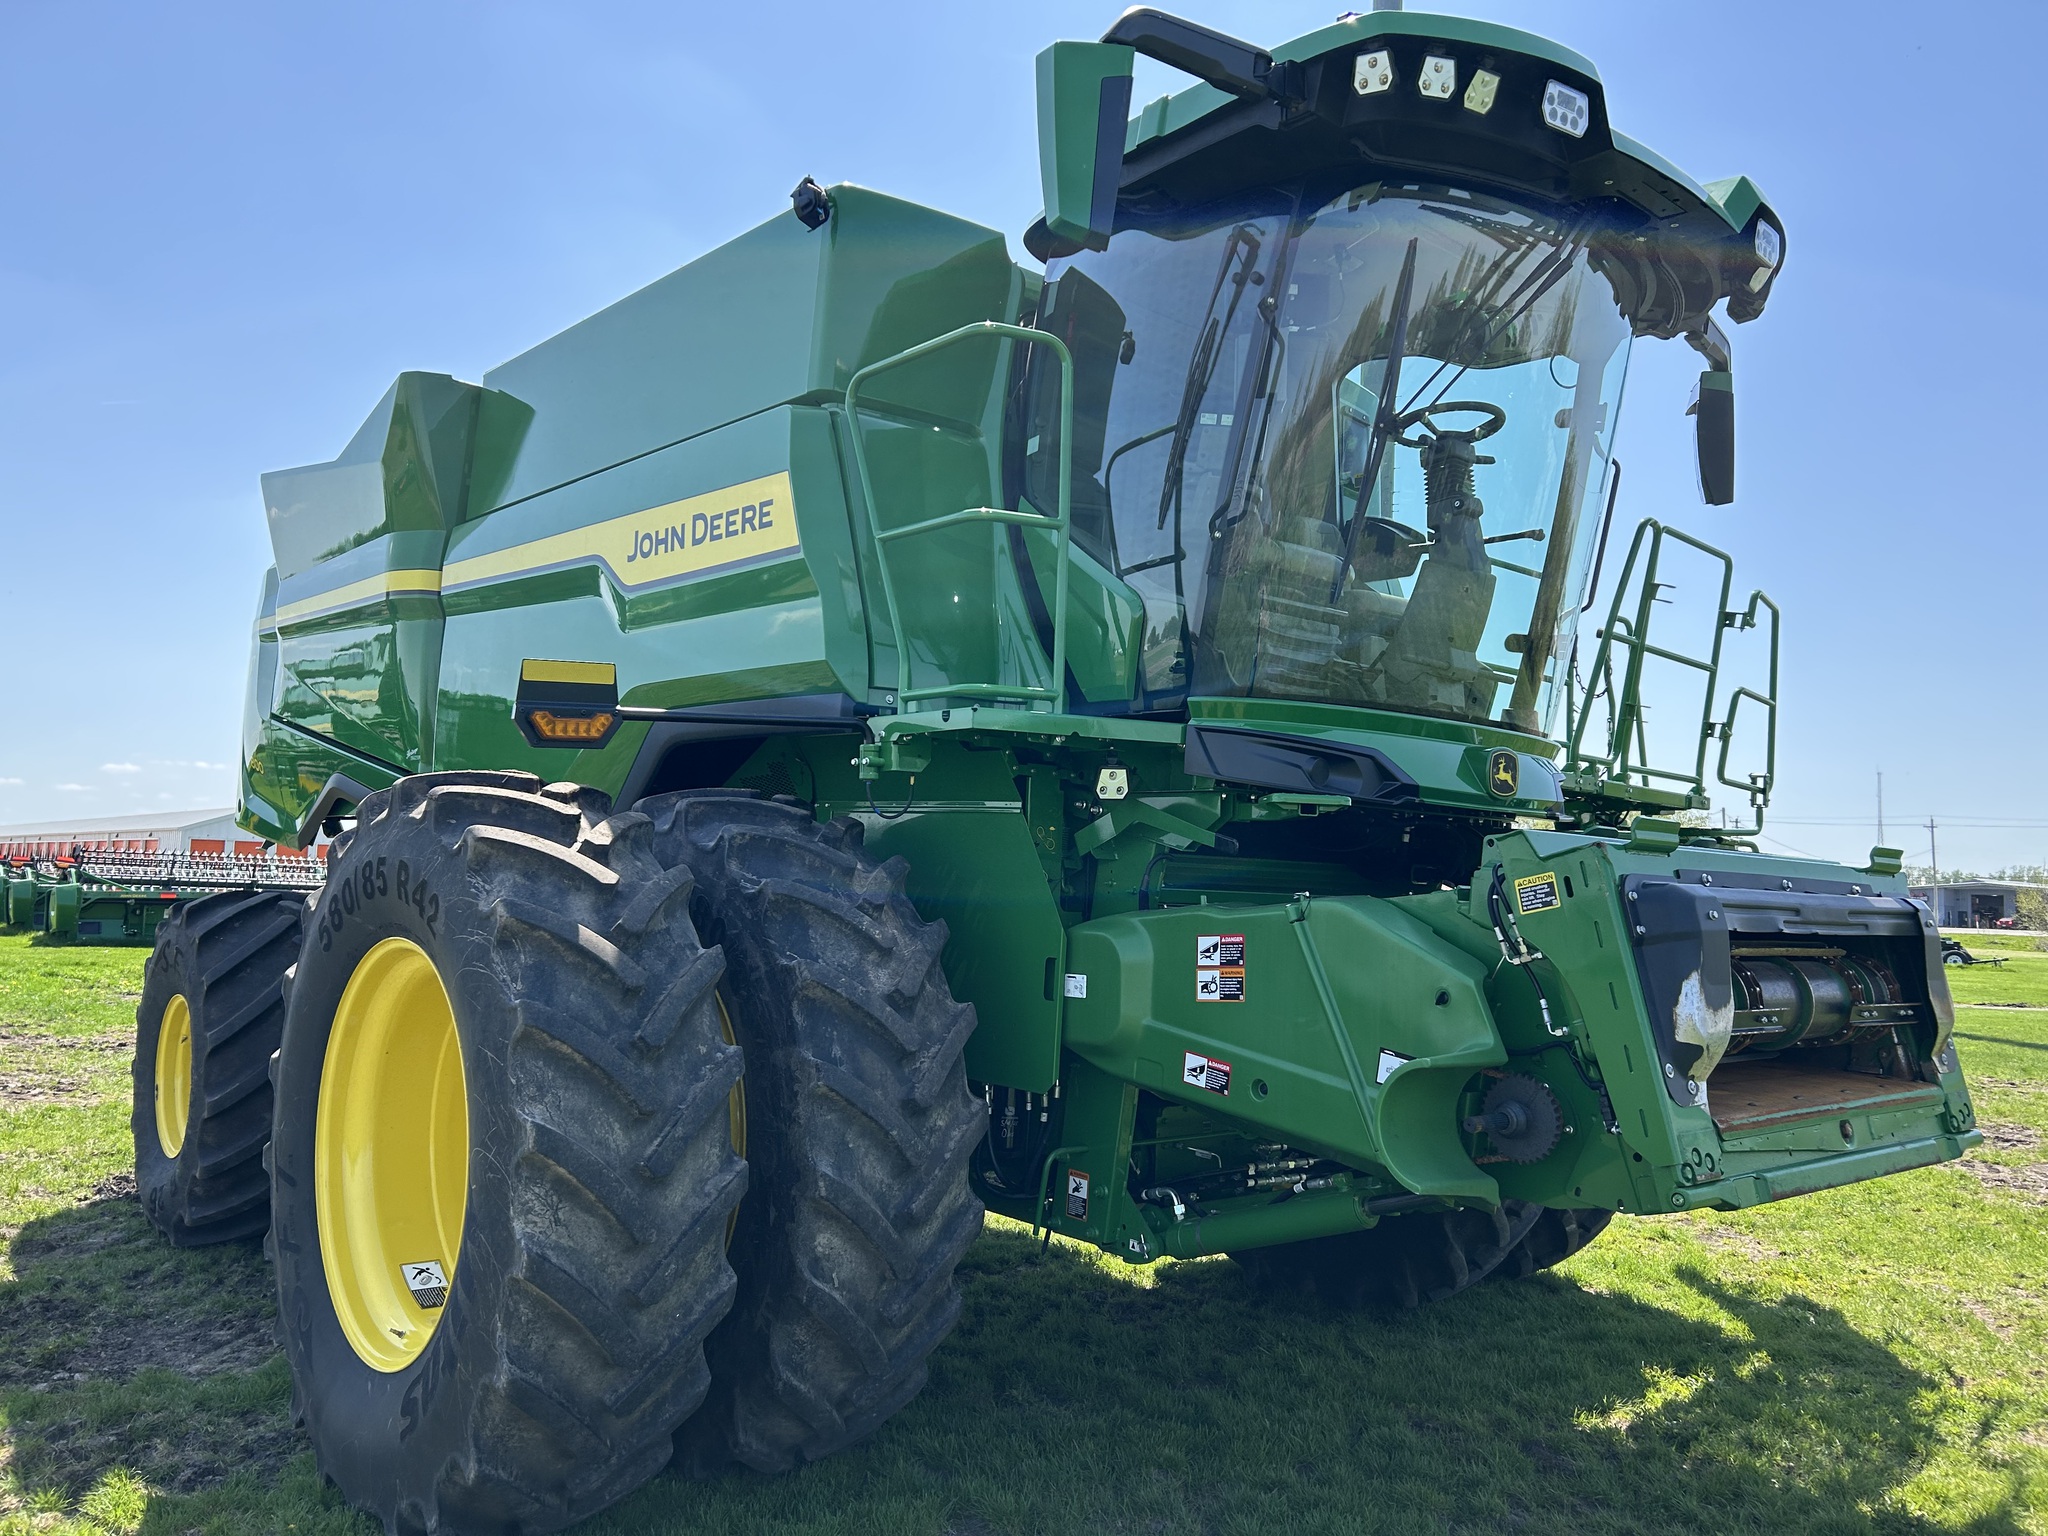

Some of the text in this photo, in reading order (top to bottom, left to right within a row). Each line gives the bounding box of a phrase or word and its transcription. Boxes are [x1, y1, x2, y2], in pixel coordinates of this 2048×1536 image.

[627, 499, 774, 563] JOHN DEERE
[1522, 874, 1553, 886] CAUTION
[318, 856, 440, 953] 580/85 R42
[1211, 1061, 1230, 1071] DANGER
